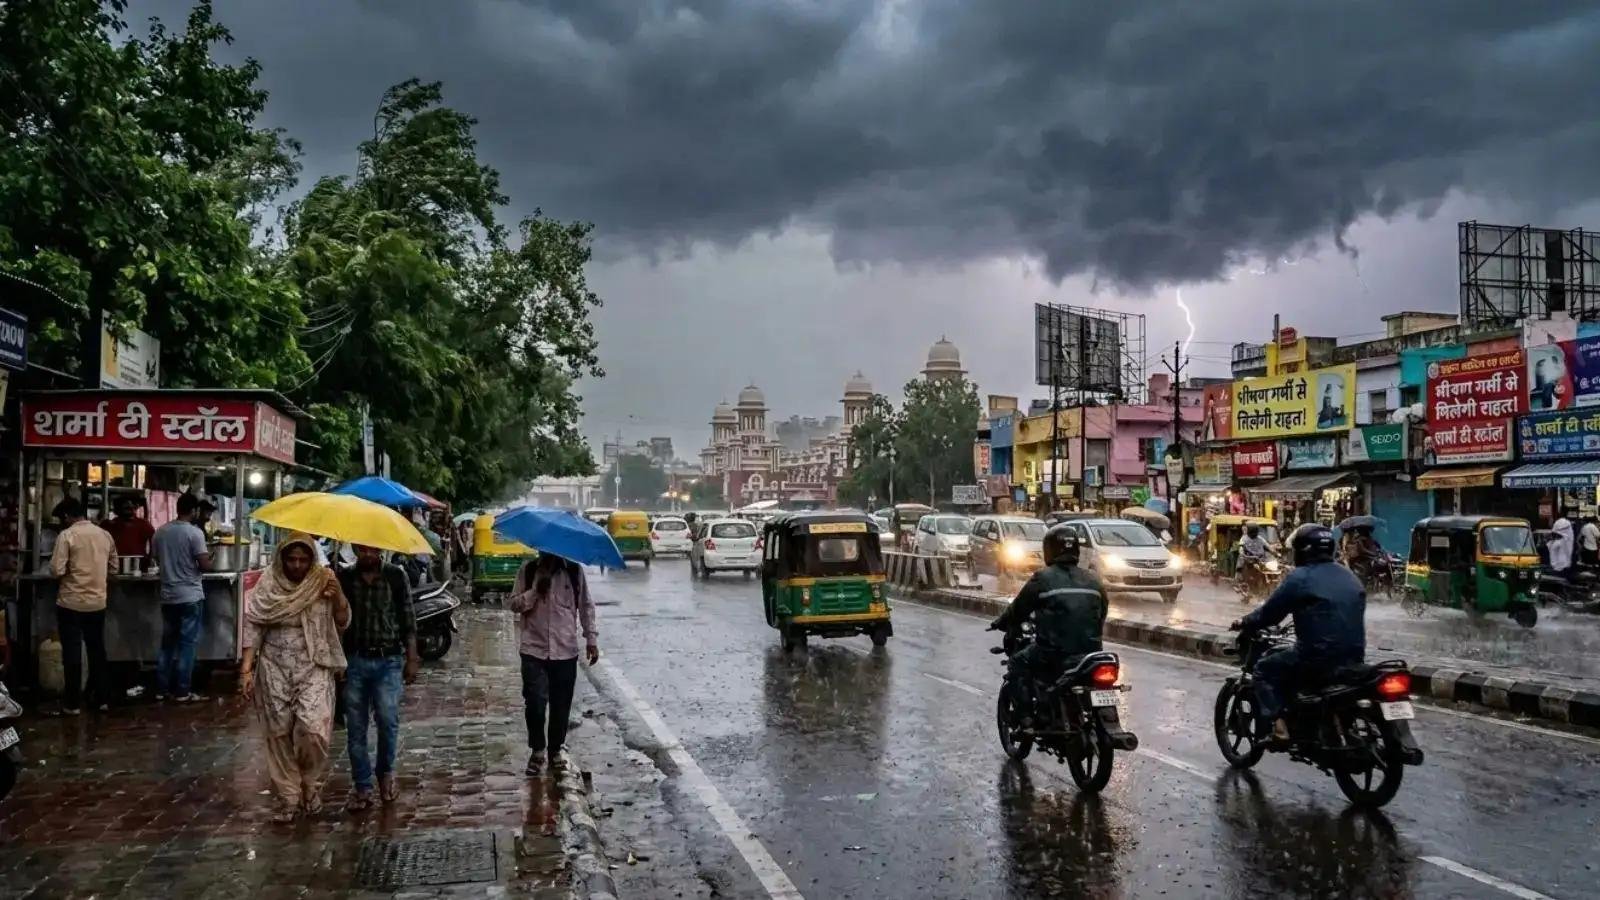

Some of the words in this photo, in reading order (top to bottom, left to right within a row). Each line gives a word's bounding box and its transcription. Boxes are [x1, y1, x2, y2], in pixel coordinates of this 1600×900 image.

[34, 401, 108, 437] शर्मा
[117, 401, 152, 439] टी
[160, 406, 249, 443] स्टॉल
